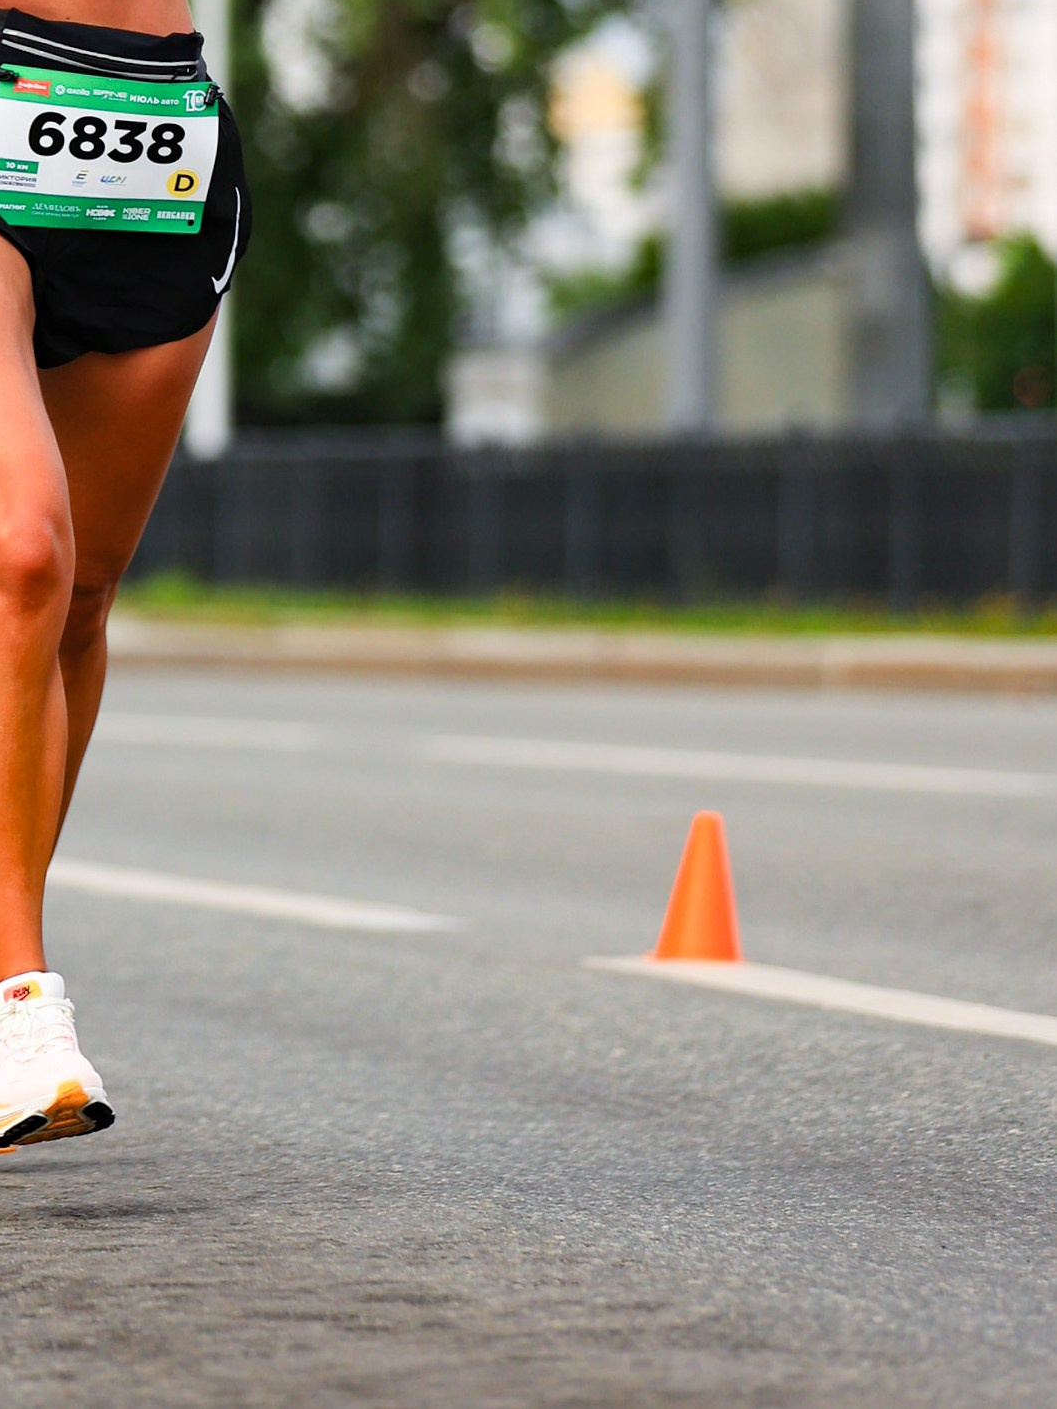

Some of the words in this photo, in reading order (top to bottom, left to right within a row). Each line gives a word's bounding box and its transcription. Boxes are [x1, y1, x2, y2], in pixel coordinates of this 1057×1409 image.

[129, 94, 160, 105] ИЮЛЬ
[28, 111, 185, 164] 6838
[174, 174, 194, 191] D
[12, 985, 30, 999] RUN
